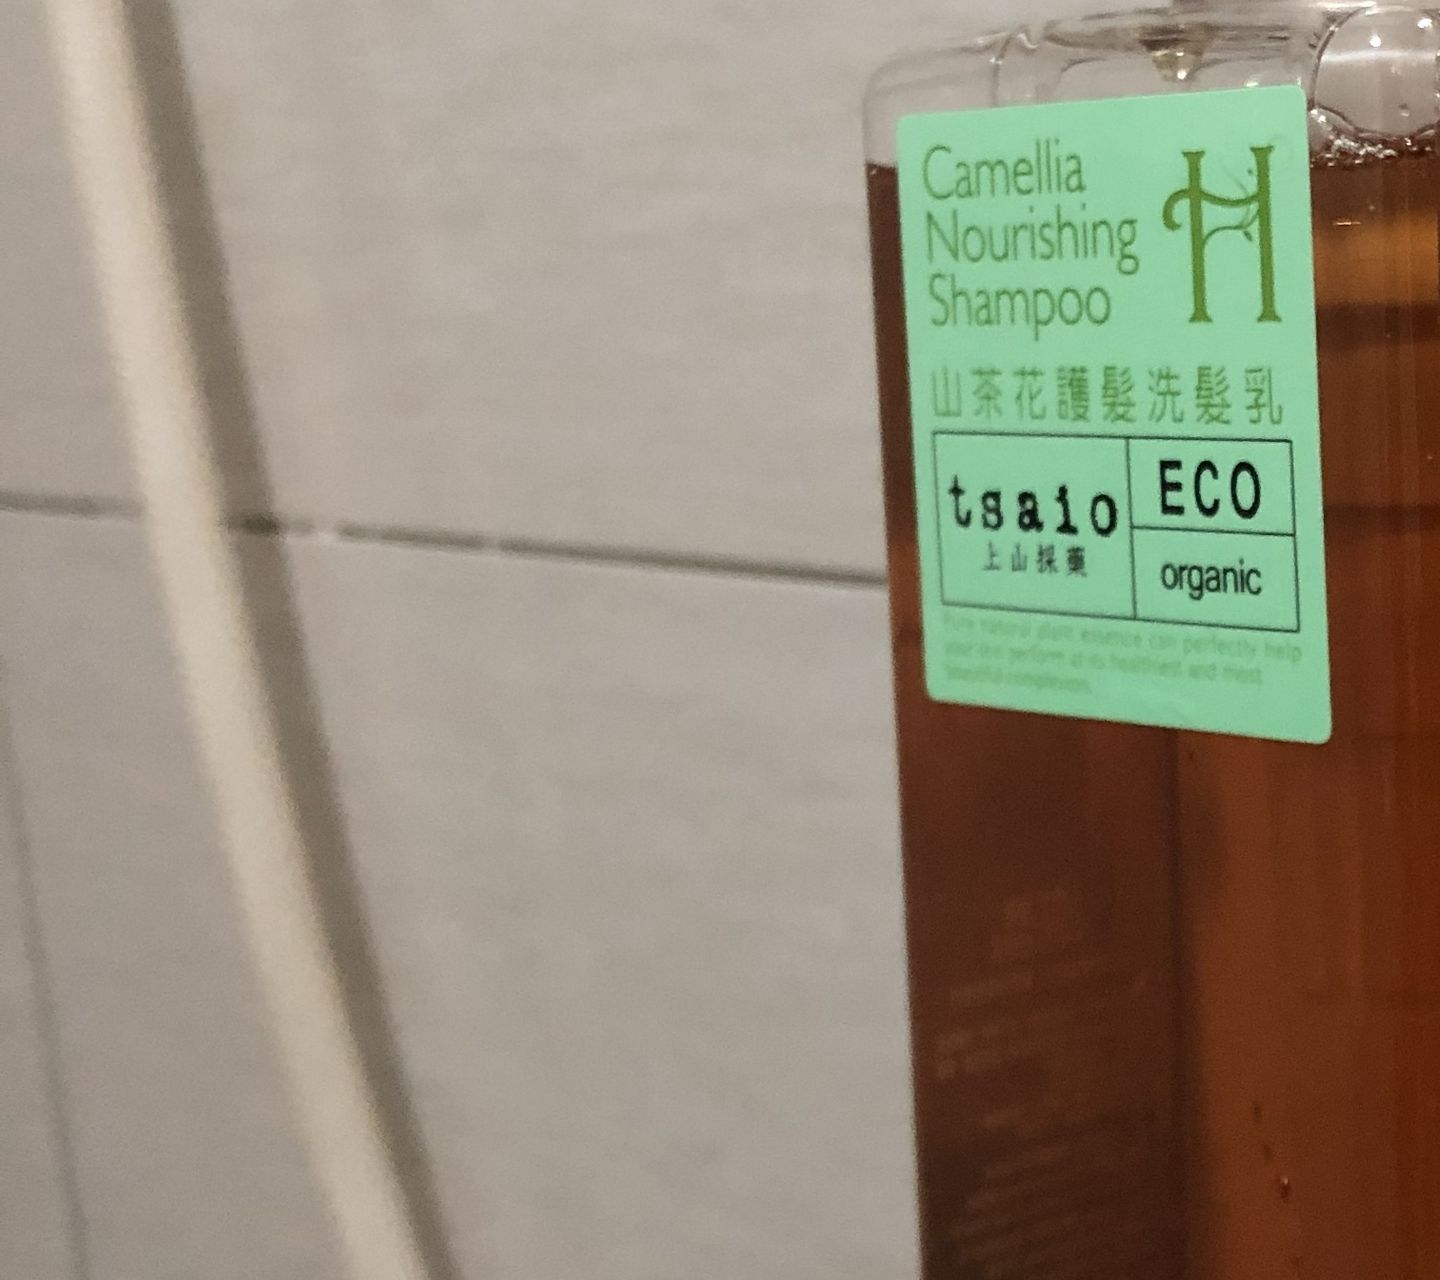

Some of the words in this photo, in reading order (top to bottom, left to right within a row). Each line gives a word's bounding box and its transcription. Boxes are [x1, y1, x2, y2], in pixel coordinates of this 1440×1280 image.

[922, 138, 1087, 201] Camellia
[925, 206, 1140, 275] Nourishing
[928, 271, 1112, 341] Shampoo
[932, 365, 1283, 425] 山茶花護髮洗髮乳
[948, 475, 1118, 537] tsaio
[1159, 459, 1261, 519] ECO
[1161, 558, 1262, 600] organic
